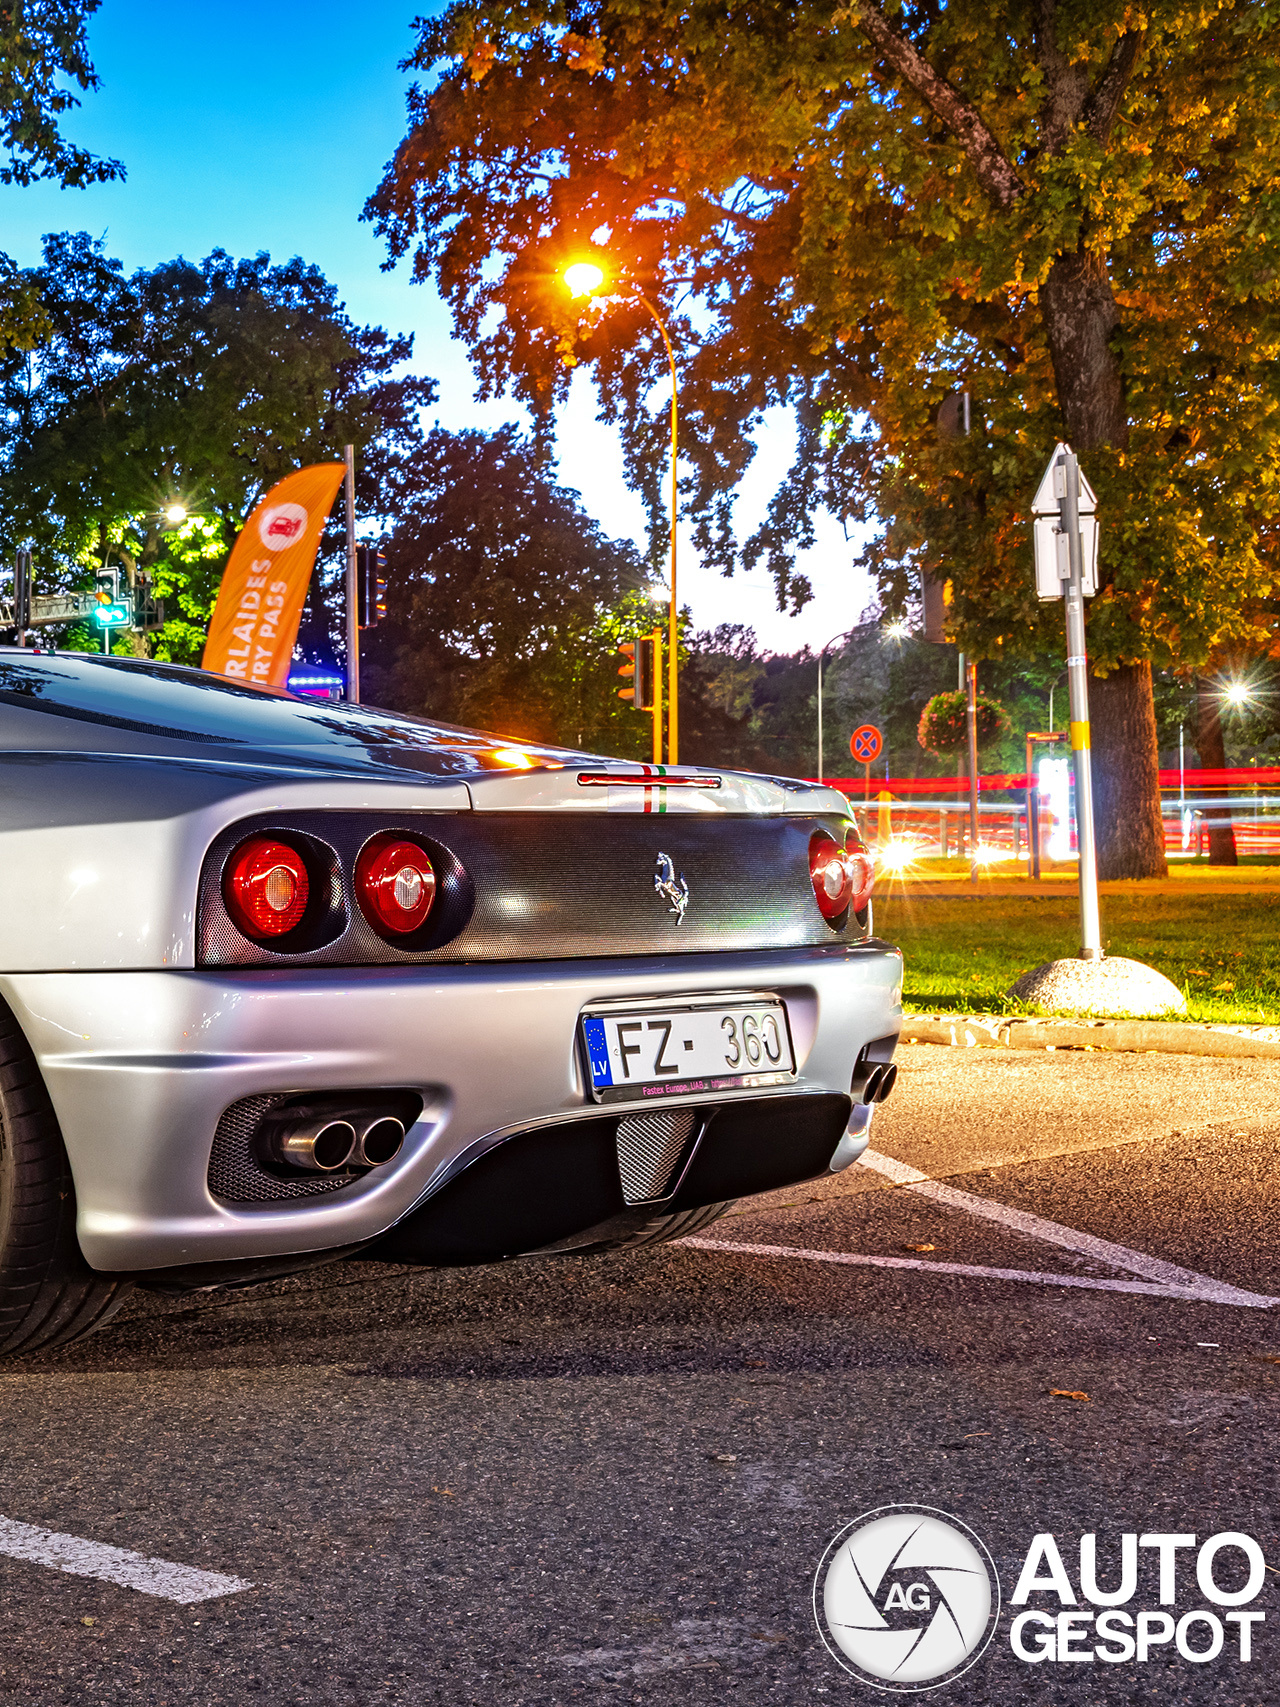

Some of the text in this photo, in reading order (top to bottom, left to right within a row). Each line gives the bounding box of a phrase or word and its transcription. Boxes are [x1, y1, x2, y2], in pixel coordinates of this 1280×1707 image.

[260, 581, 287, 638] PASS
[592, 1060, 608, 1077] LV
[642, 1085, 665, 1096] Fastex
[665, 1083, 689, 1093] Europe,
[690, 1081, 704, 1091] UAB
